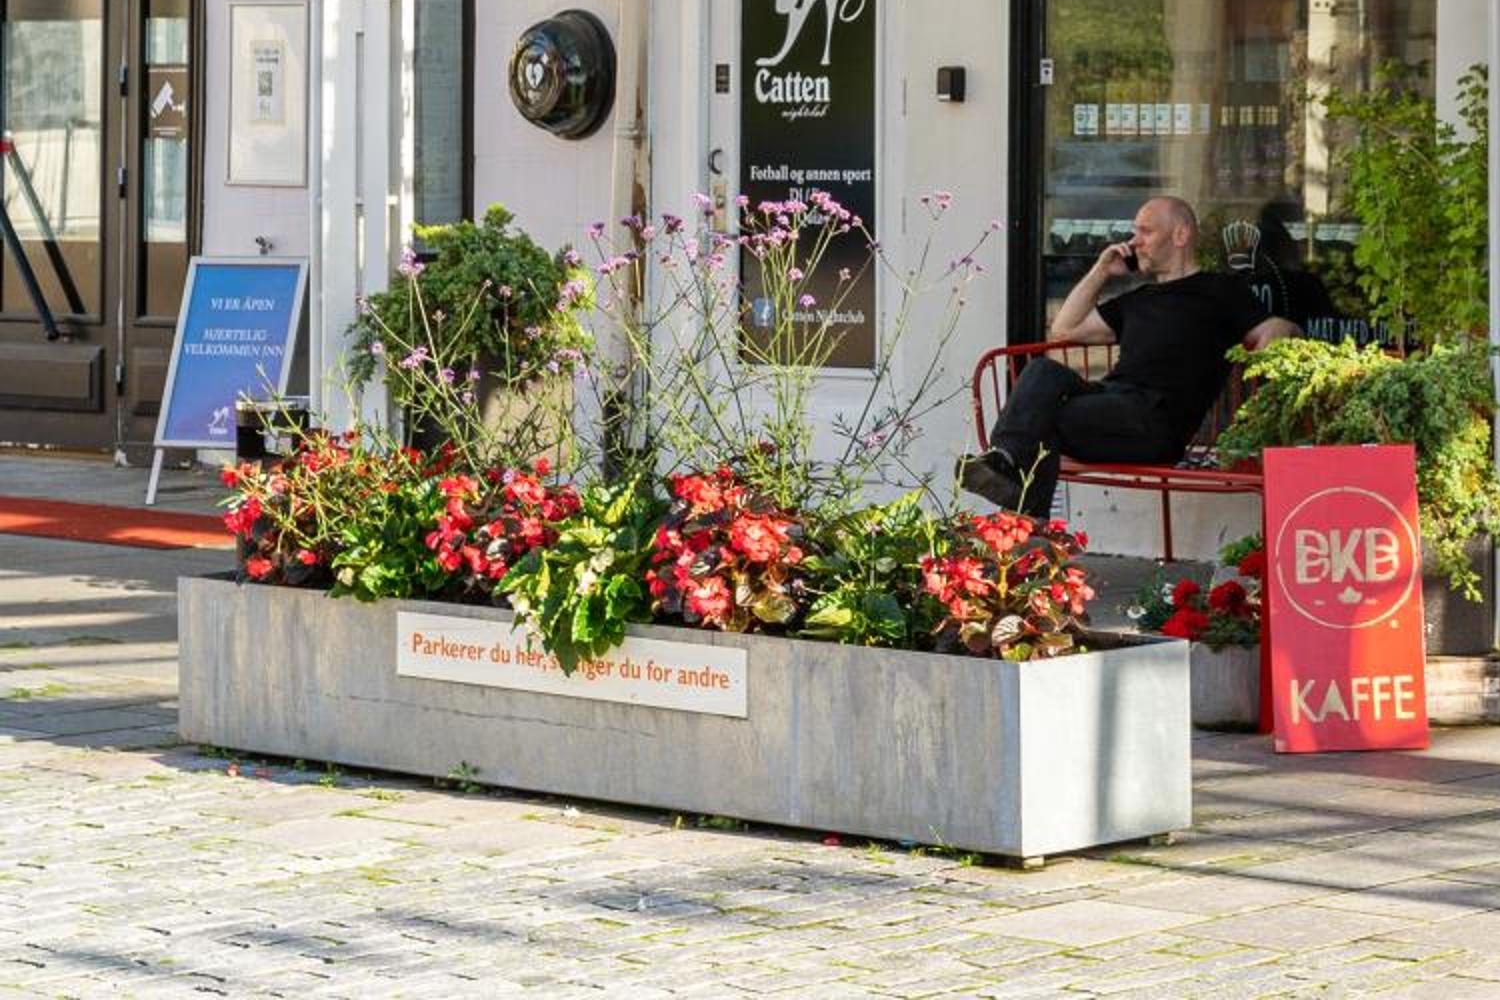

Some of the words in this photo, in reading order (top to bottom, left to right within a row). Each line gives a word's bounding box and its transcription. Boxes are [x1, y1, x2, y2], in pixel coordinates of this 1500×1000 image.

[755, 68, 831, 103] Catten
[751, 165, 788, 180] Fotball
[790, 169, 804, 184] og
[805, 169, 840, 181] annen
[842, 169, 871, 185] sport
[211, 298, 223, 310] VI
[224, 298, 240, 310] ER
[243, 296, 275, 311] ÅPEN
[184, 344, 260, 357] VELKOMMEN
[1296, 528, 1399, 584] BKB
[412, 632, 484, 661] Parkerer
[490, 642, 511, 665] du
[619, 655, 642, 679] du
[645, 658, 673, 683] for
[677, 665, 730, 690] andre
[1290, 675, 1417, 724] KAFFE
